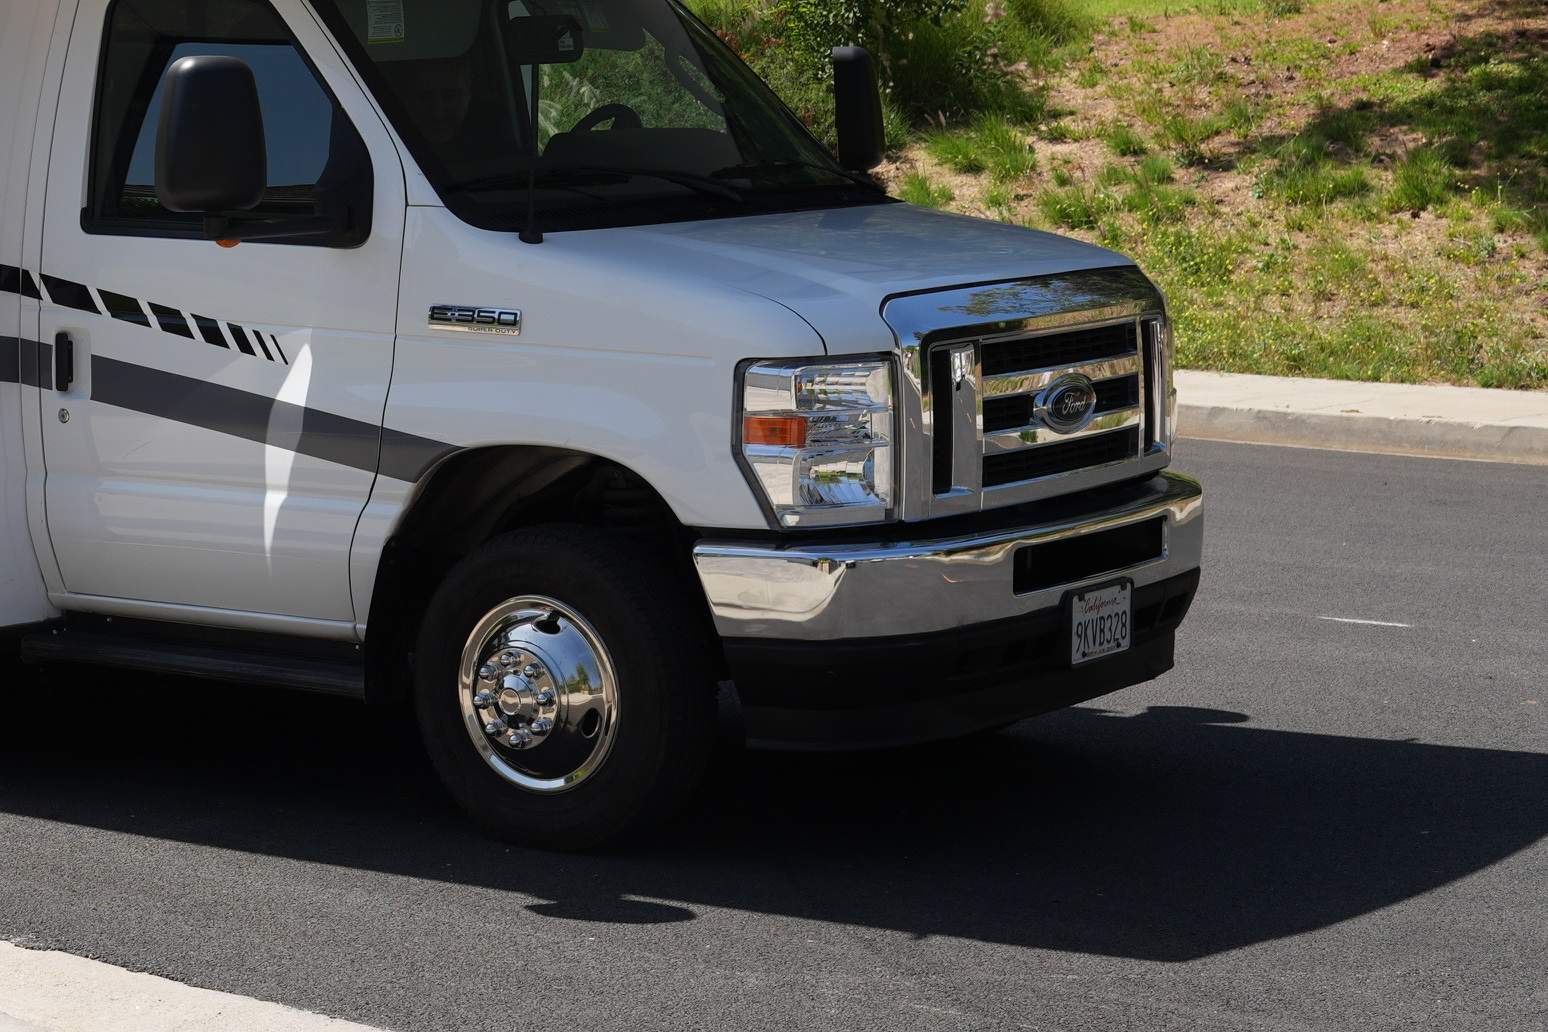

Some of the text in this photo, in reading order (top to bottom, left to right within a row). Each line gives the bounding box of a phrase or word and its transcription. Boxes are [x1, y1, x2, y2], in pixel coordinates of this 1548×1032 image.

[1061, 391, 1087, 415] Ford
[19, 505, 48, 516] WINEGA
[1084, 595, 1120, 615] California
[1076, 610, 1127, 653] 9KVB328
